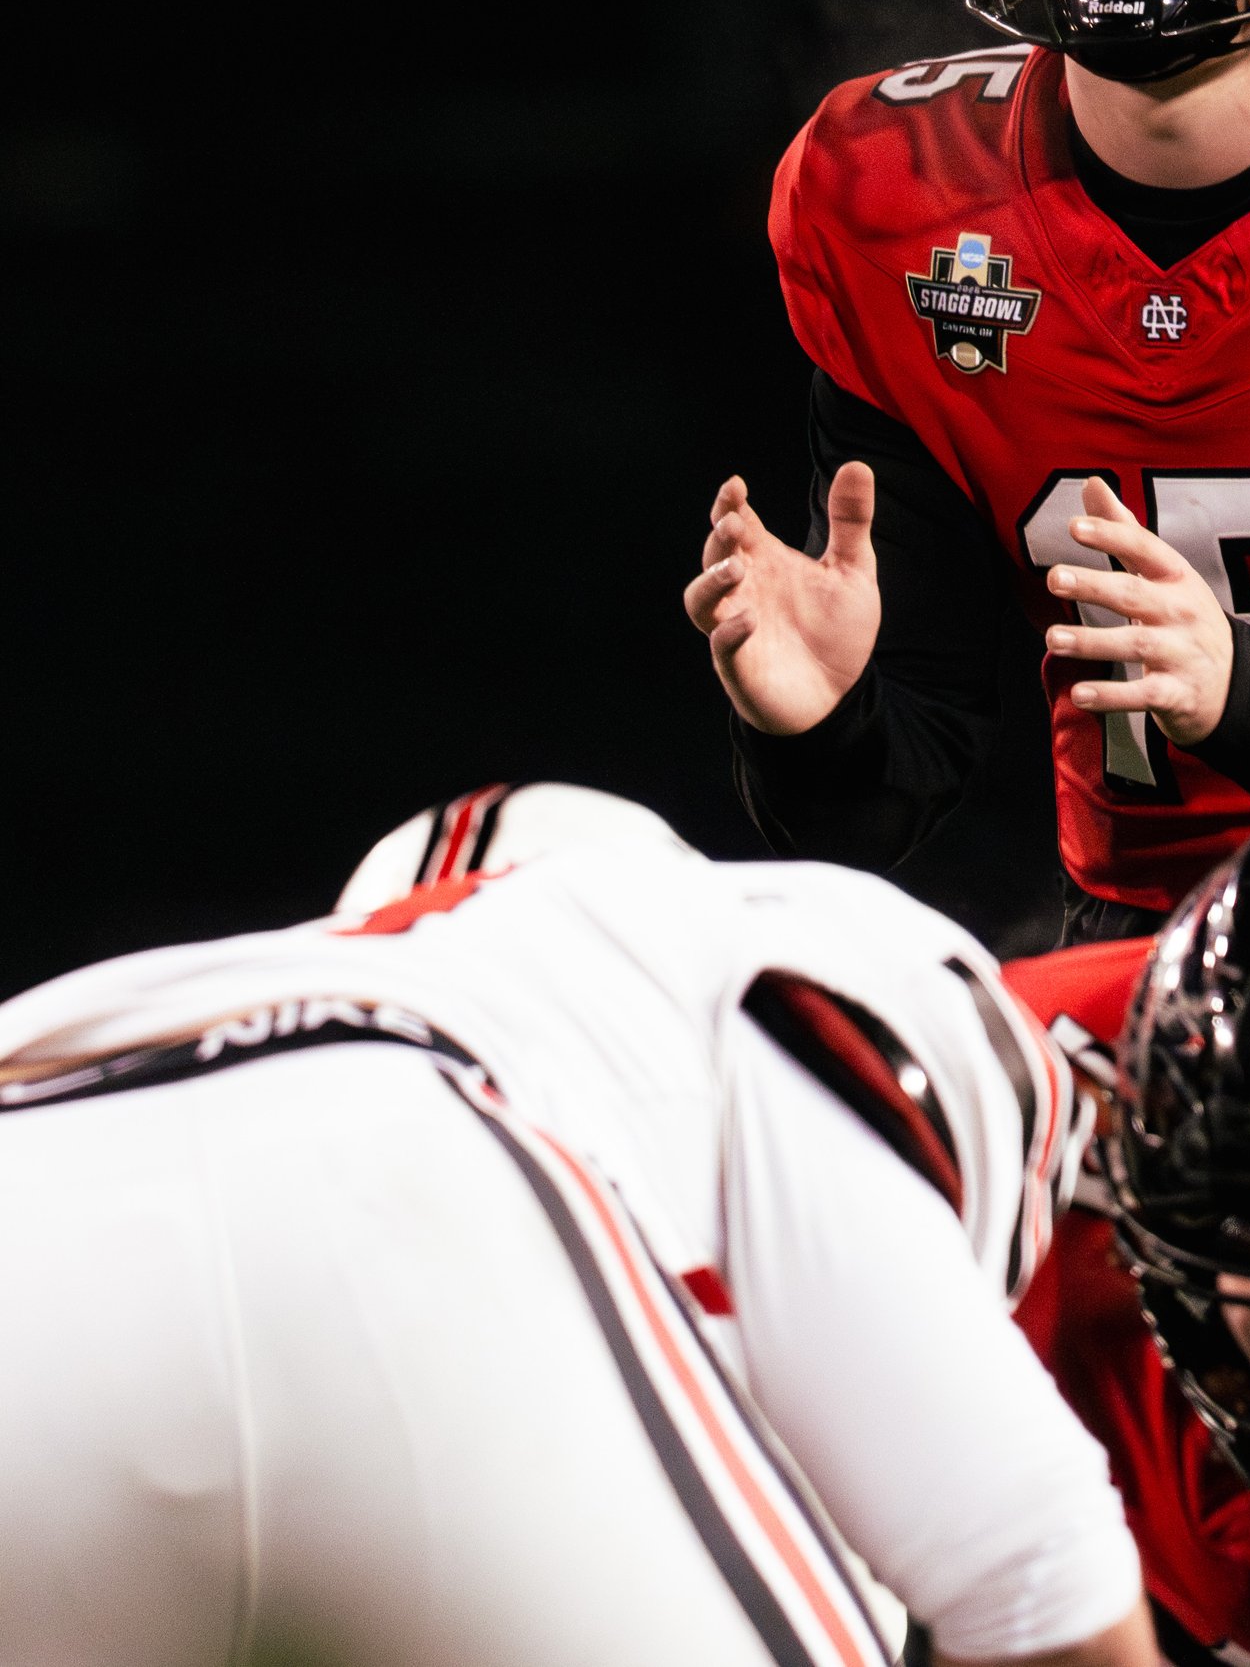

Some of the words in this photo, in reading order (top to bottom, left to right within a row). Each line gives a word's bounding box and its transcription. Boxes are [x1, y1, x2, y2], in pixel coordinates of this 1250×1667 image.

[1088, 0, 1145, 15] Riddell
[920, 288, 971, 315] STAGG
[971, 296, 1023, 322] BOWL
